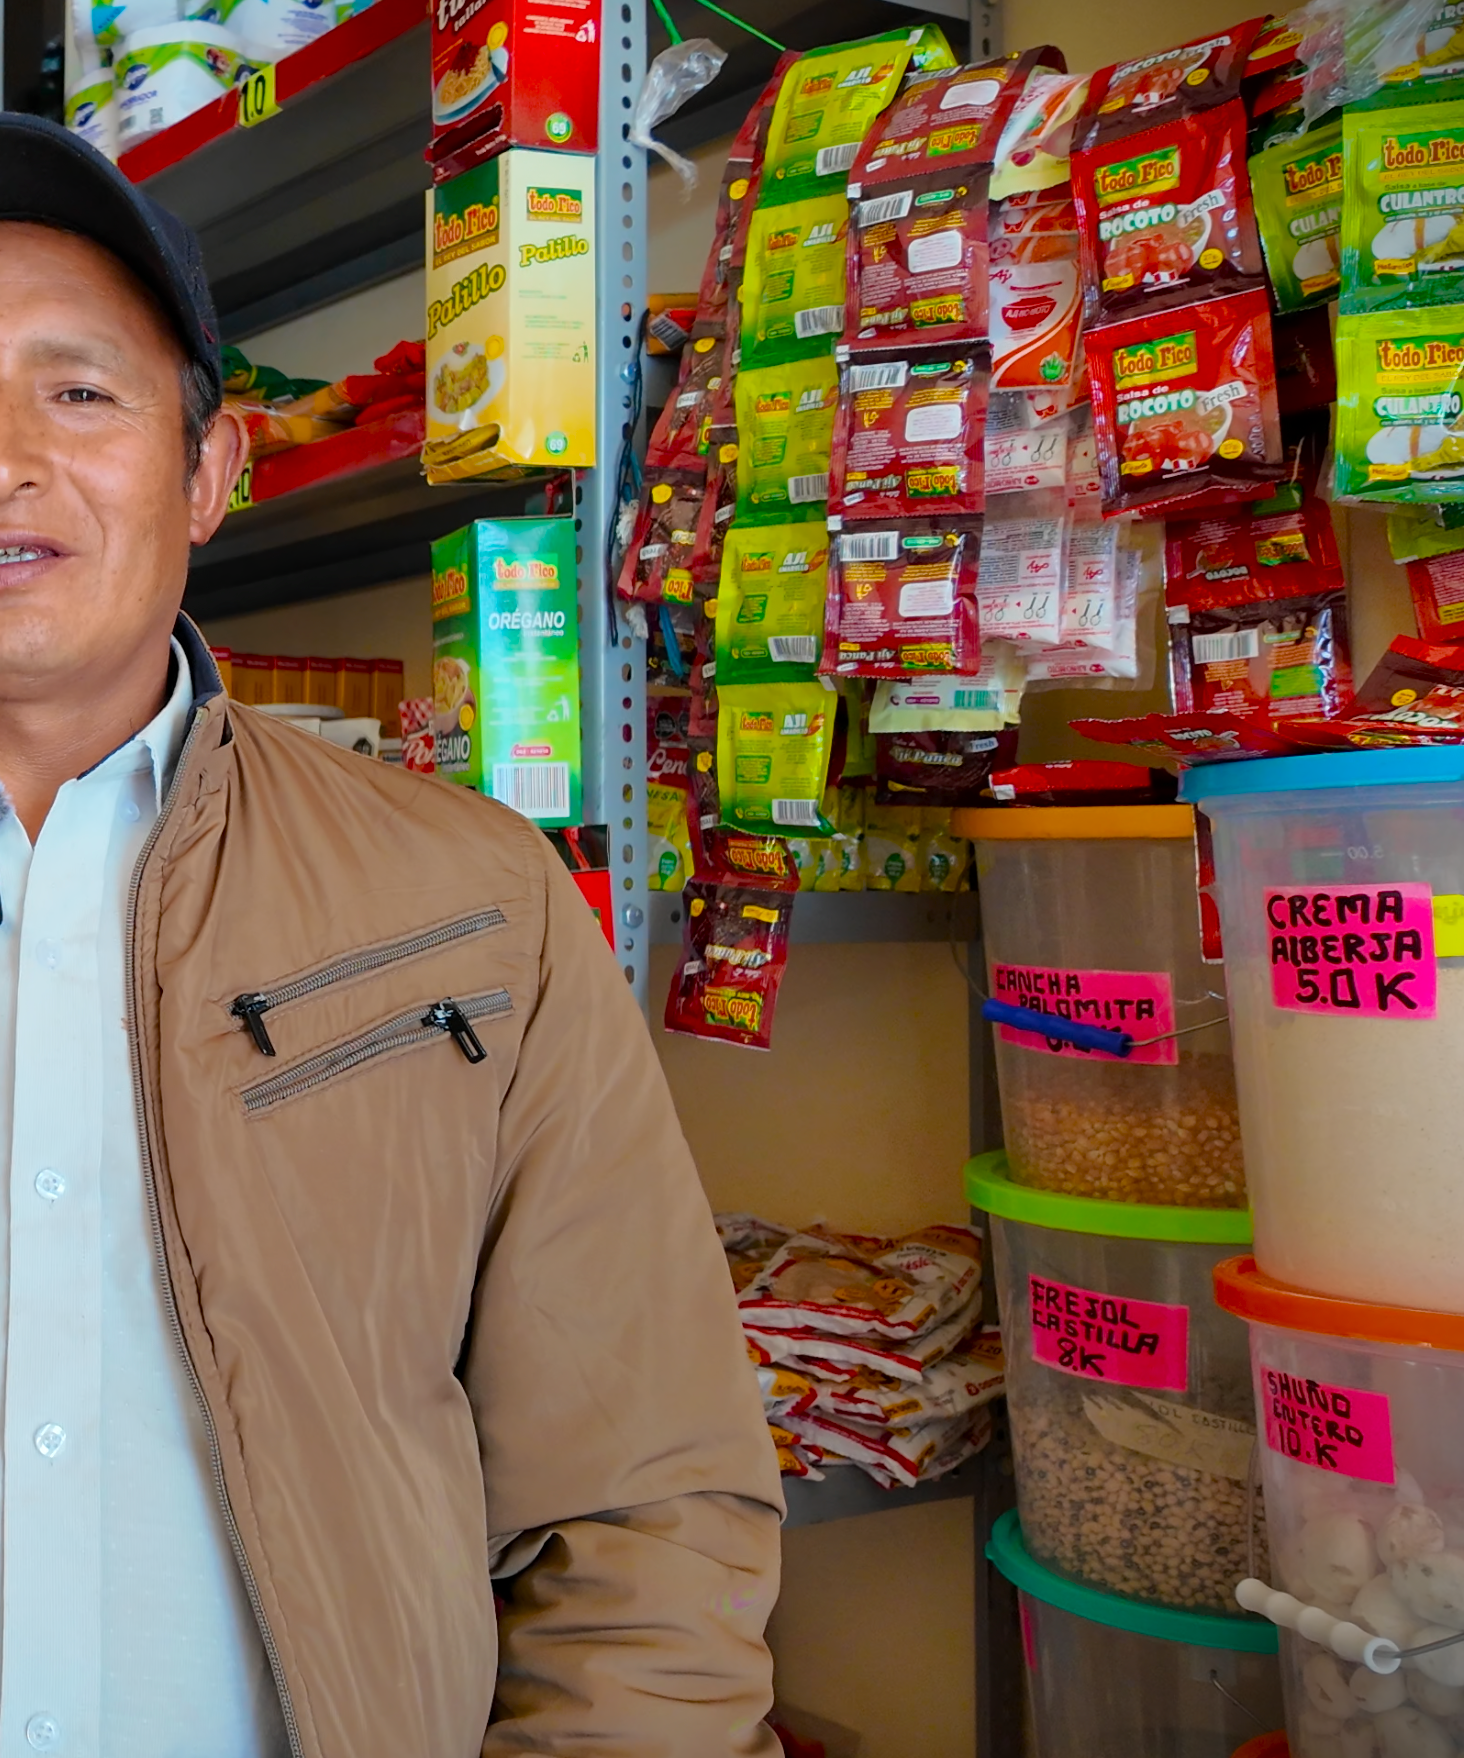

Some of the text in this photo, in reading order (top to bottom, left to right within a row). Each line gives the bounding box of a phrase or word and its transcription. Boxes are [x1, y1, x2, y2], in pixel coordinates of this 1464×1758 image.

[1384, 138, 1425, 168] todo
[1099, 167, 1136, 194] todo
[1287, 163, 1324, 192] todo
[1098, 203, 1177, 240] ROCOTO
[519, 234, 589, 267] Palillo
[427, 262, 507, 340] Palillo
[1116, 350, 1154, 376] todo
[1379, 340, 1419, 369] todo
[1116, 383, 1170, 402] Salsa de
[1116, 390, 1197, 424] ROCOTO
[1200, 383, 1242, 413] Fresh
[488, 608, 566, 631] ORÉGANO
[1266, 889, 1404, 930] CREMA
[996, 968, 1082, 997] CANCHA
[1374, 971, 1419, 1011] K
[1030, 1279, 1141, 1330] FREJOL
[1032, 1308, 1160, 1356] CASTILLA
[1272, 1398, 1365, 1449] ENTERO
